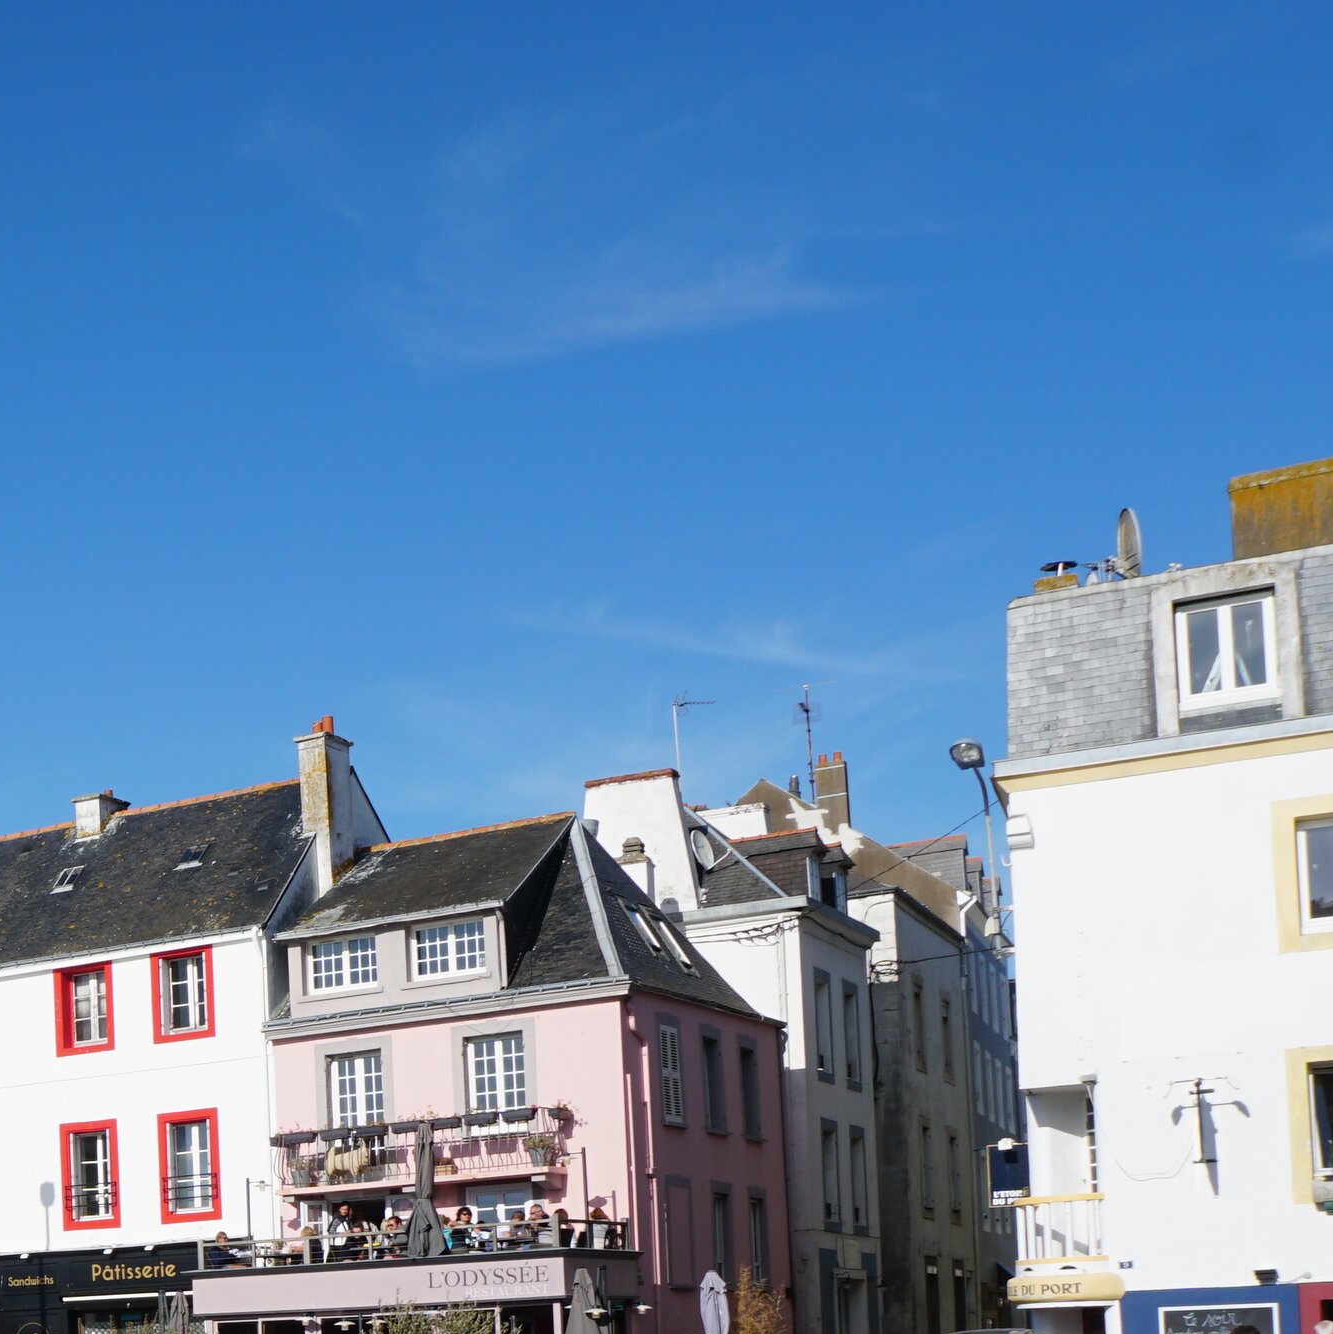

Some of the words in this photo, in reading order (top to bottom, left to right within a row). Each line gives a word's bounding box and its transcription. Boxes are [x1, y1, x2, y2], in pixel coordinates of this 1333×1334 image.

[91, 1261, 177, 1282] Pâtisserie
[427, 1262, 550, 1289] L'ODYSSÉE
[7, 1274, 55, 1288] Sandwichs
[464, 1284, 550, 1297] RESTAURANT
[1021, 1284, 1035, 1296] DU
[1041, 1282, 1082, 1296] PORT
